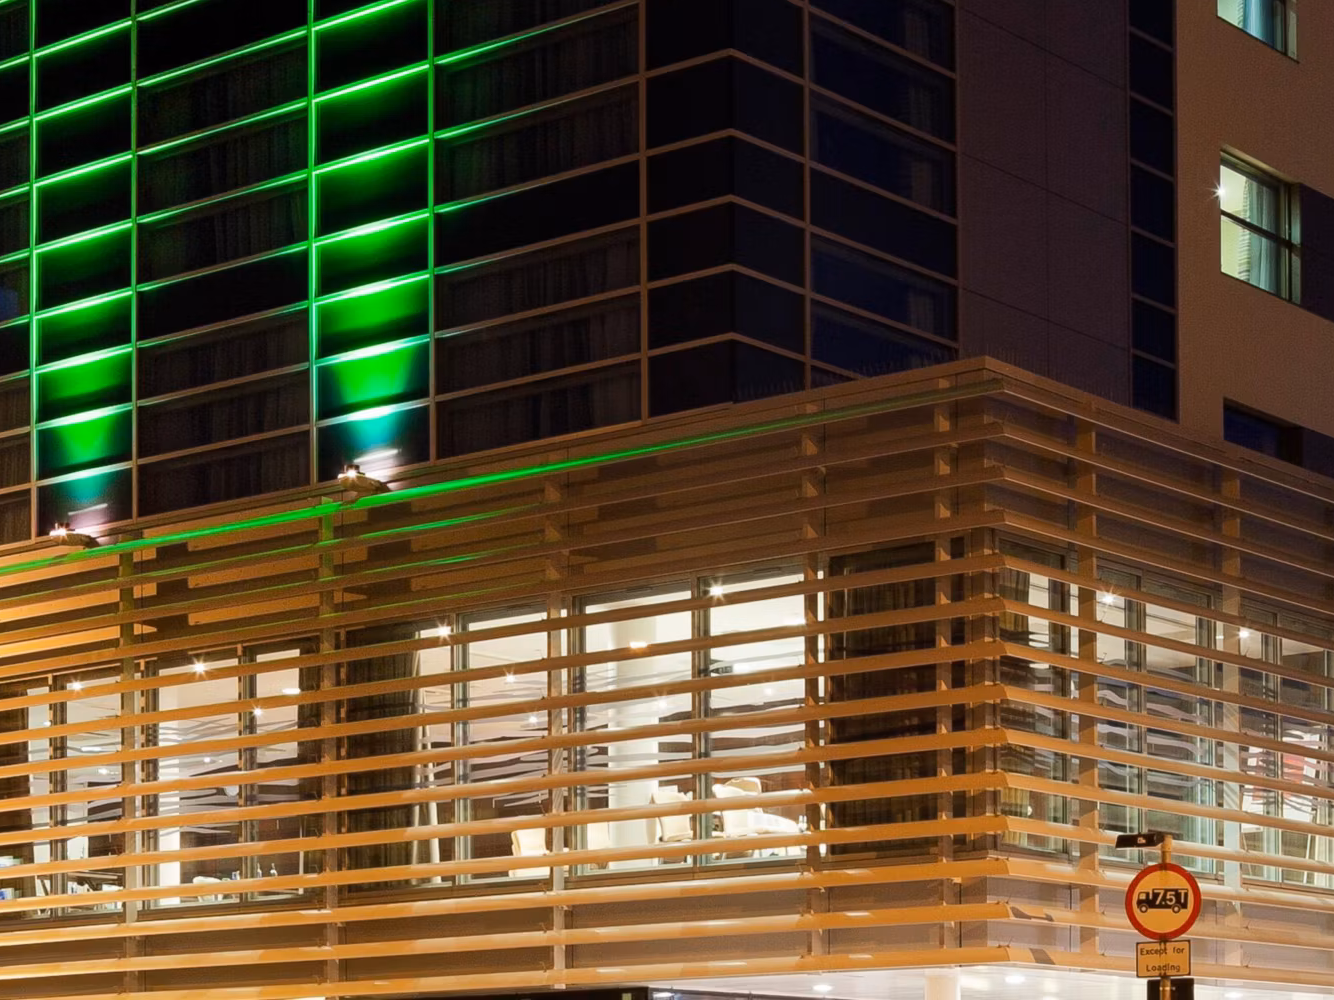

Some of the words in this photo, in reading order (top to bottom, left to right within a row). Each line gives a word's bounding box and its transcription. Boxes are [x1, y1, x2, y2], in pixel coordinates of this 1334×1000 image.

[1139, 947, 1168, 958] Except
[1172, 946, 1185, 955] for
[1145, 963, 1181, 973] Loading
